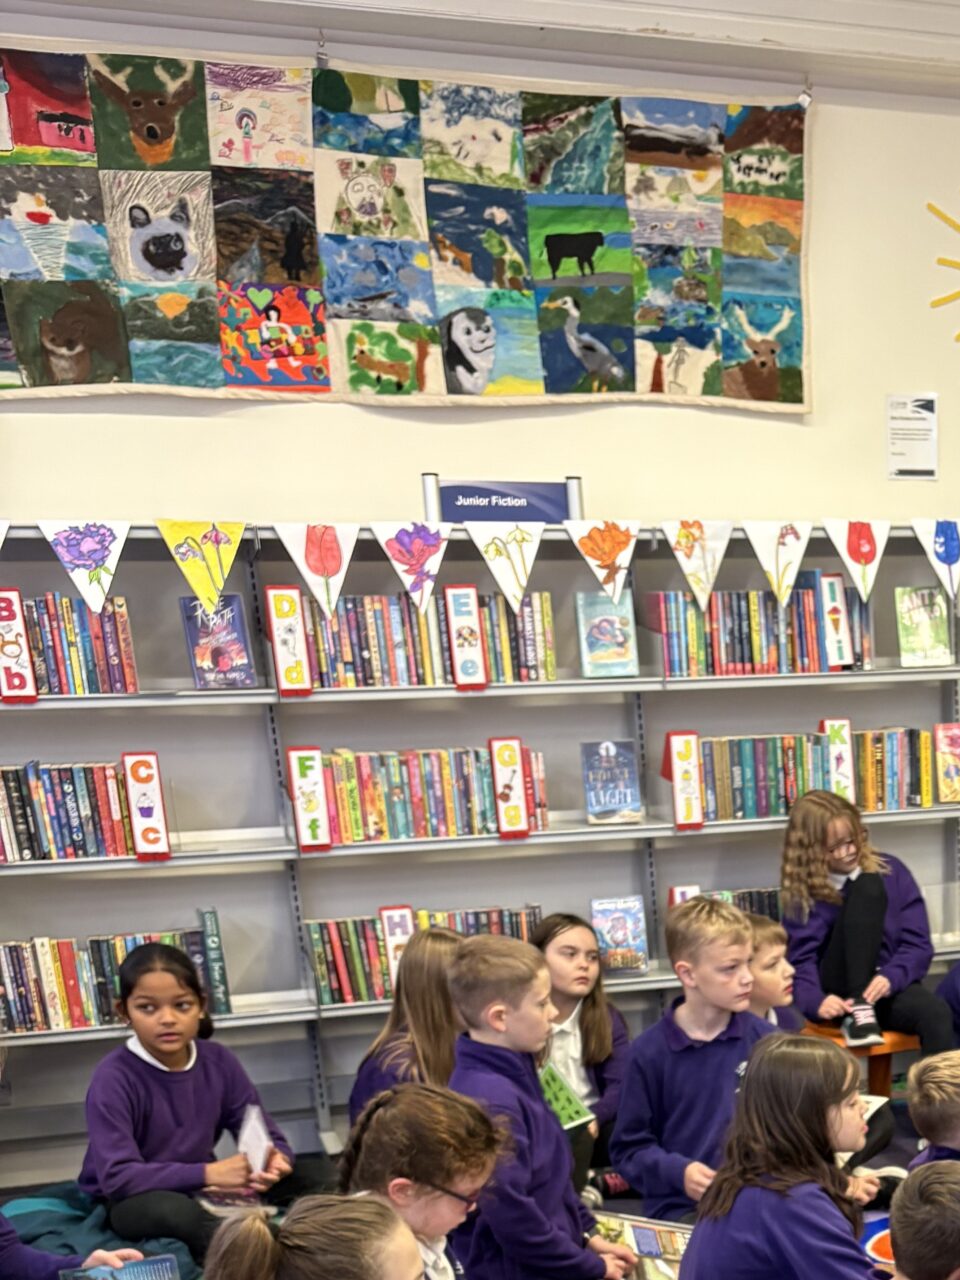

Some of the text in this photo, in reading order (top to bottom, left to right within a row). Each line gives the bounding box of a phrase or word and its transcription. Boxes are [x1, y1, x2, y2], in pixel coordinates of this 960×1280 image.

[454, 495, 527, 507] Junior Fiction
[0, 598, 17, 622] B
[273, 594, 297, 619] D
[452, 593, 473, 617] E
[3, 666, 27, 690] b
[284, 660, 305, 684] d
[460, 659, 478, 677] e
[829, 724, 848, 744] K
[496, 744, 517, 767] G
[677, 739, 692, 761] J
[130, 760, 154, 784] C
[297, 755, 316, 778] F
[504, 805, 522, 827] g
[309, 818, 320, 840] f
[386, 914, 409, 936] H
